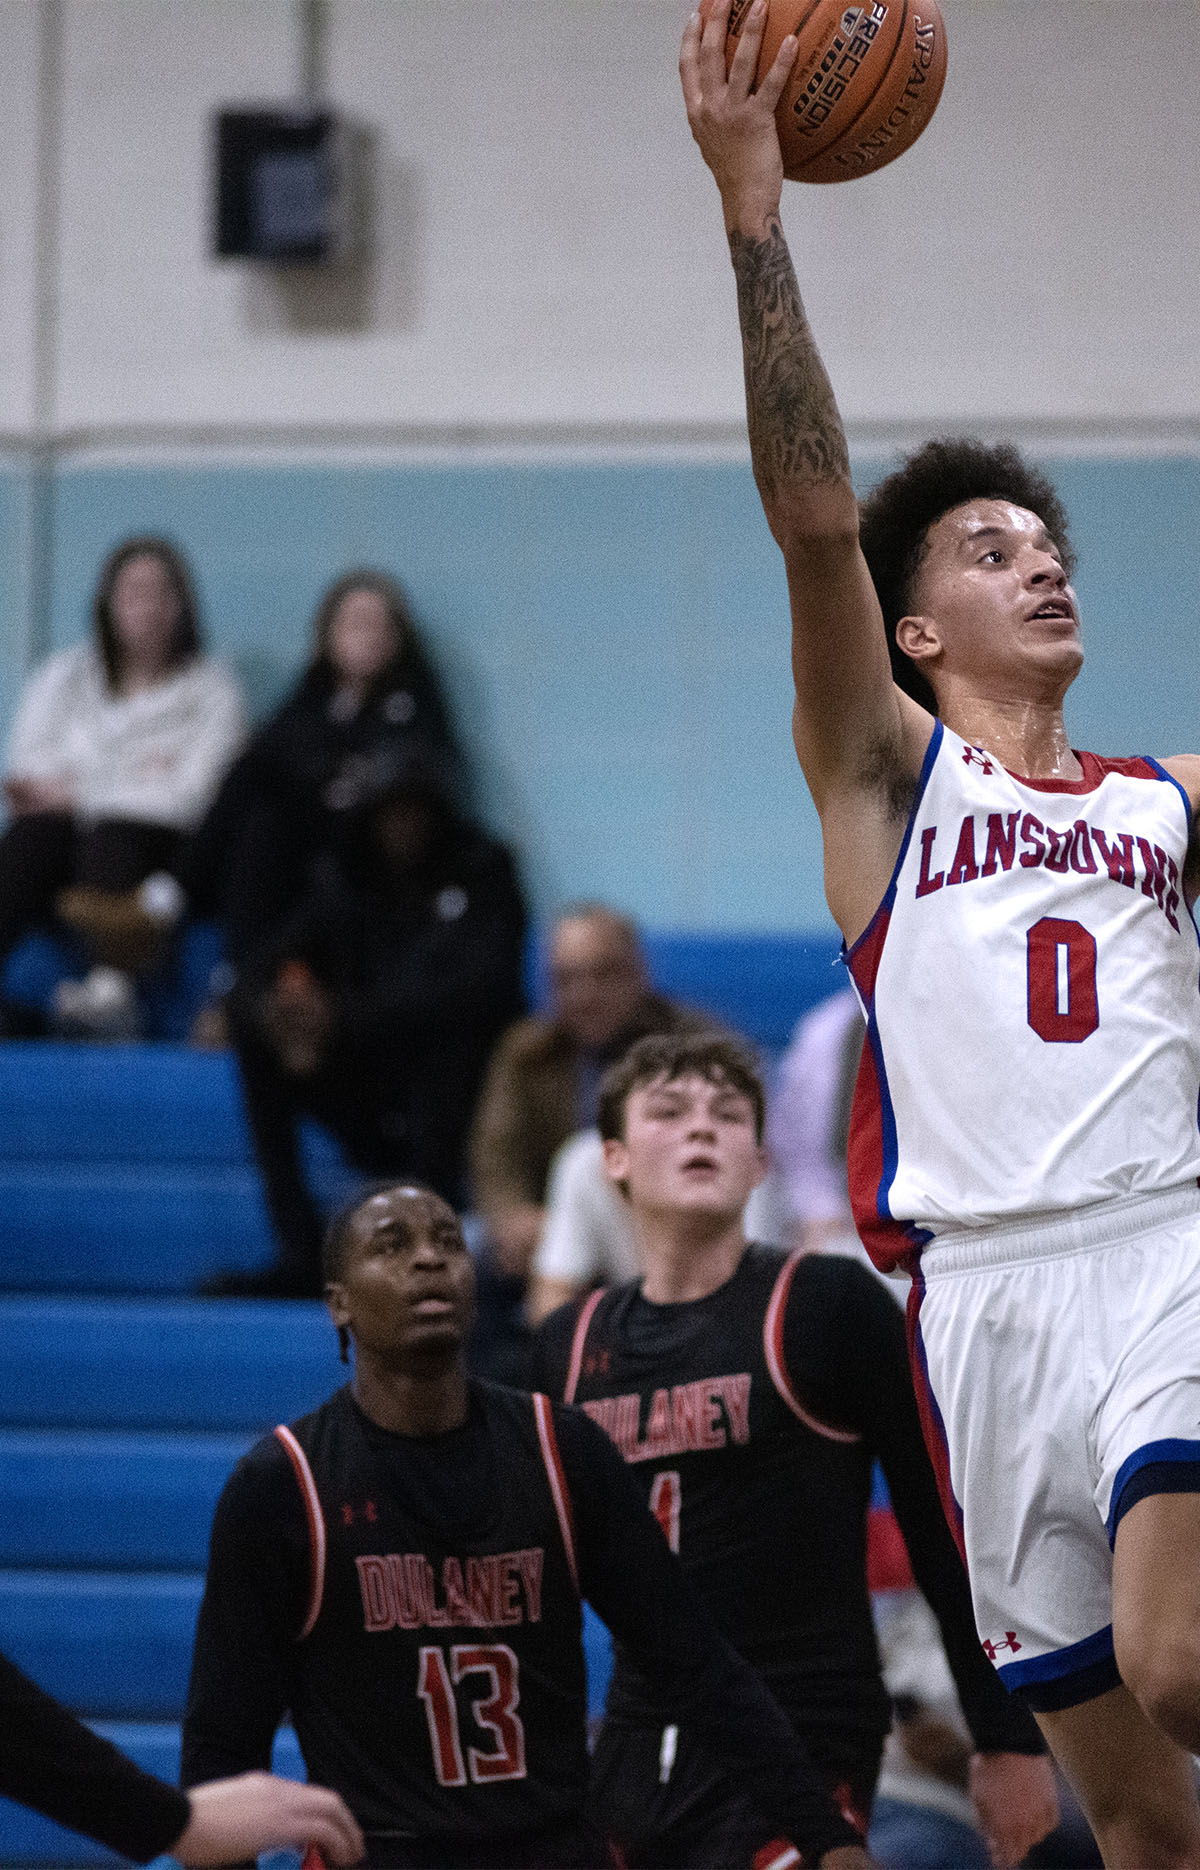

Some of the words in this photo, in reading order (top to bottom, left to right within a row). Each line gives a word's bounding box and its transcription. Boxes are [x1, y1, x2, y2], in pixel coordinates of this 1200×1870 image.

[793, 35, 845, 115] 1000
[797, 0, 888, 137] PRECISION
[834, 15, 936, 165] SPALDING
[1027, 916, 1100, 1043] 0
[582, 1372, 752, 1464] ULANEY
[355, 1547, 544, 1632] DULANEY
[417, 1644, 527, 1787] 13
